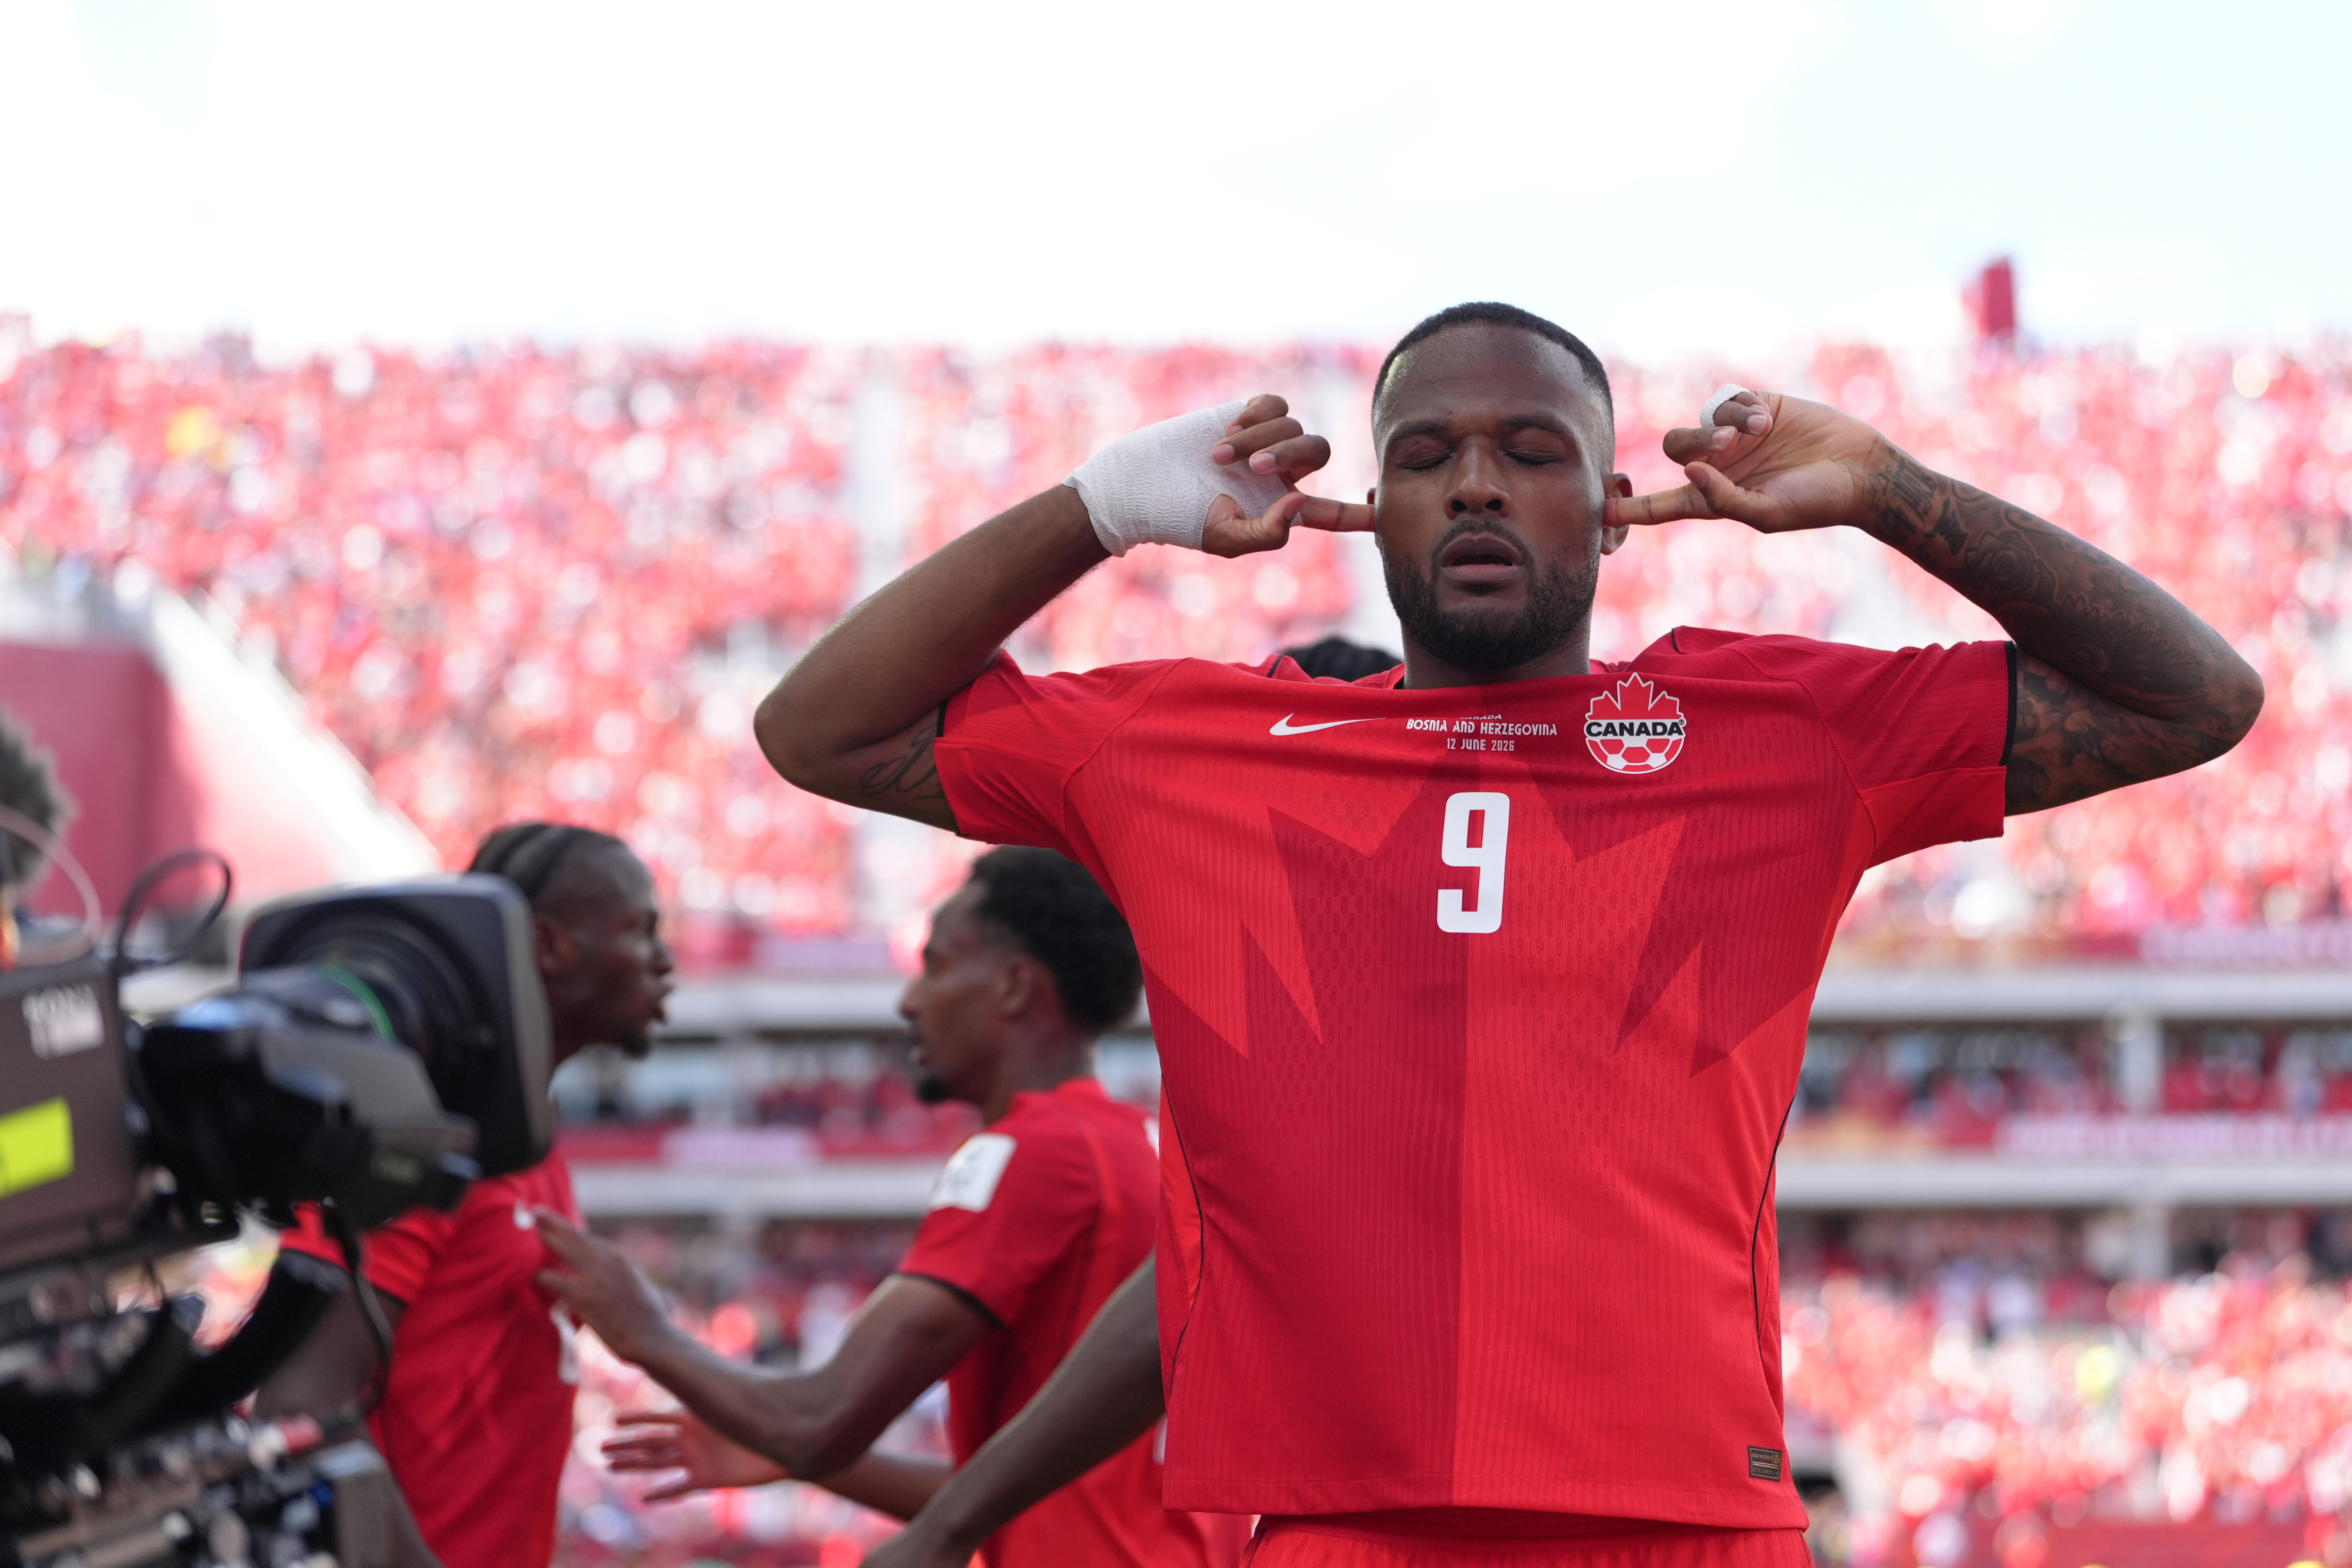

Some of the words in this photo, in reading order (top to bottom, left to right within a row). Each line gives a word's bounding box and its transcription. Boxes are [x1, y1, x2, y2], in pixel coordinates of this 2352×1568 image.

[1406, 718, 1448, 732] BOSNIA
[1452, 721, 1475, 733] AND
[1480, 722, 1557, 735] HERZEGOVINA
[1586, 722, 1683, 737] CANADA
[1447, 738, 1456, 750] 12
[1460, 738, 1486, 751] JUNE
[1491, 740, 1514, 751] 2026
[1437, 792, 1510, 934] 9
